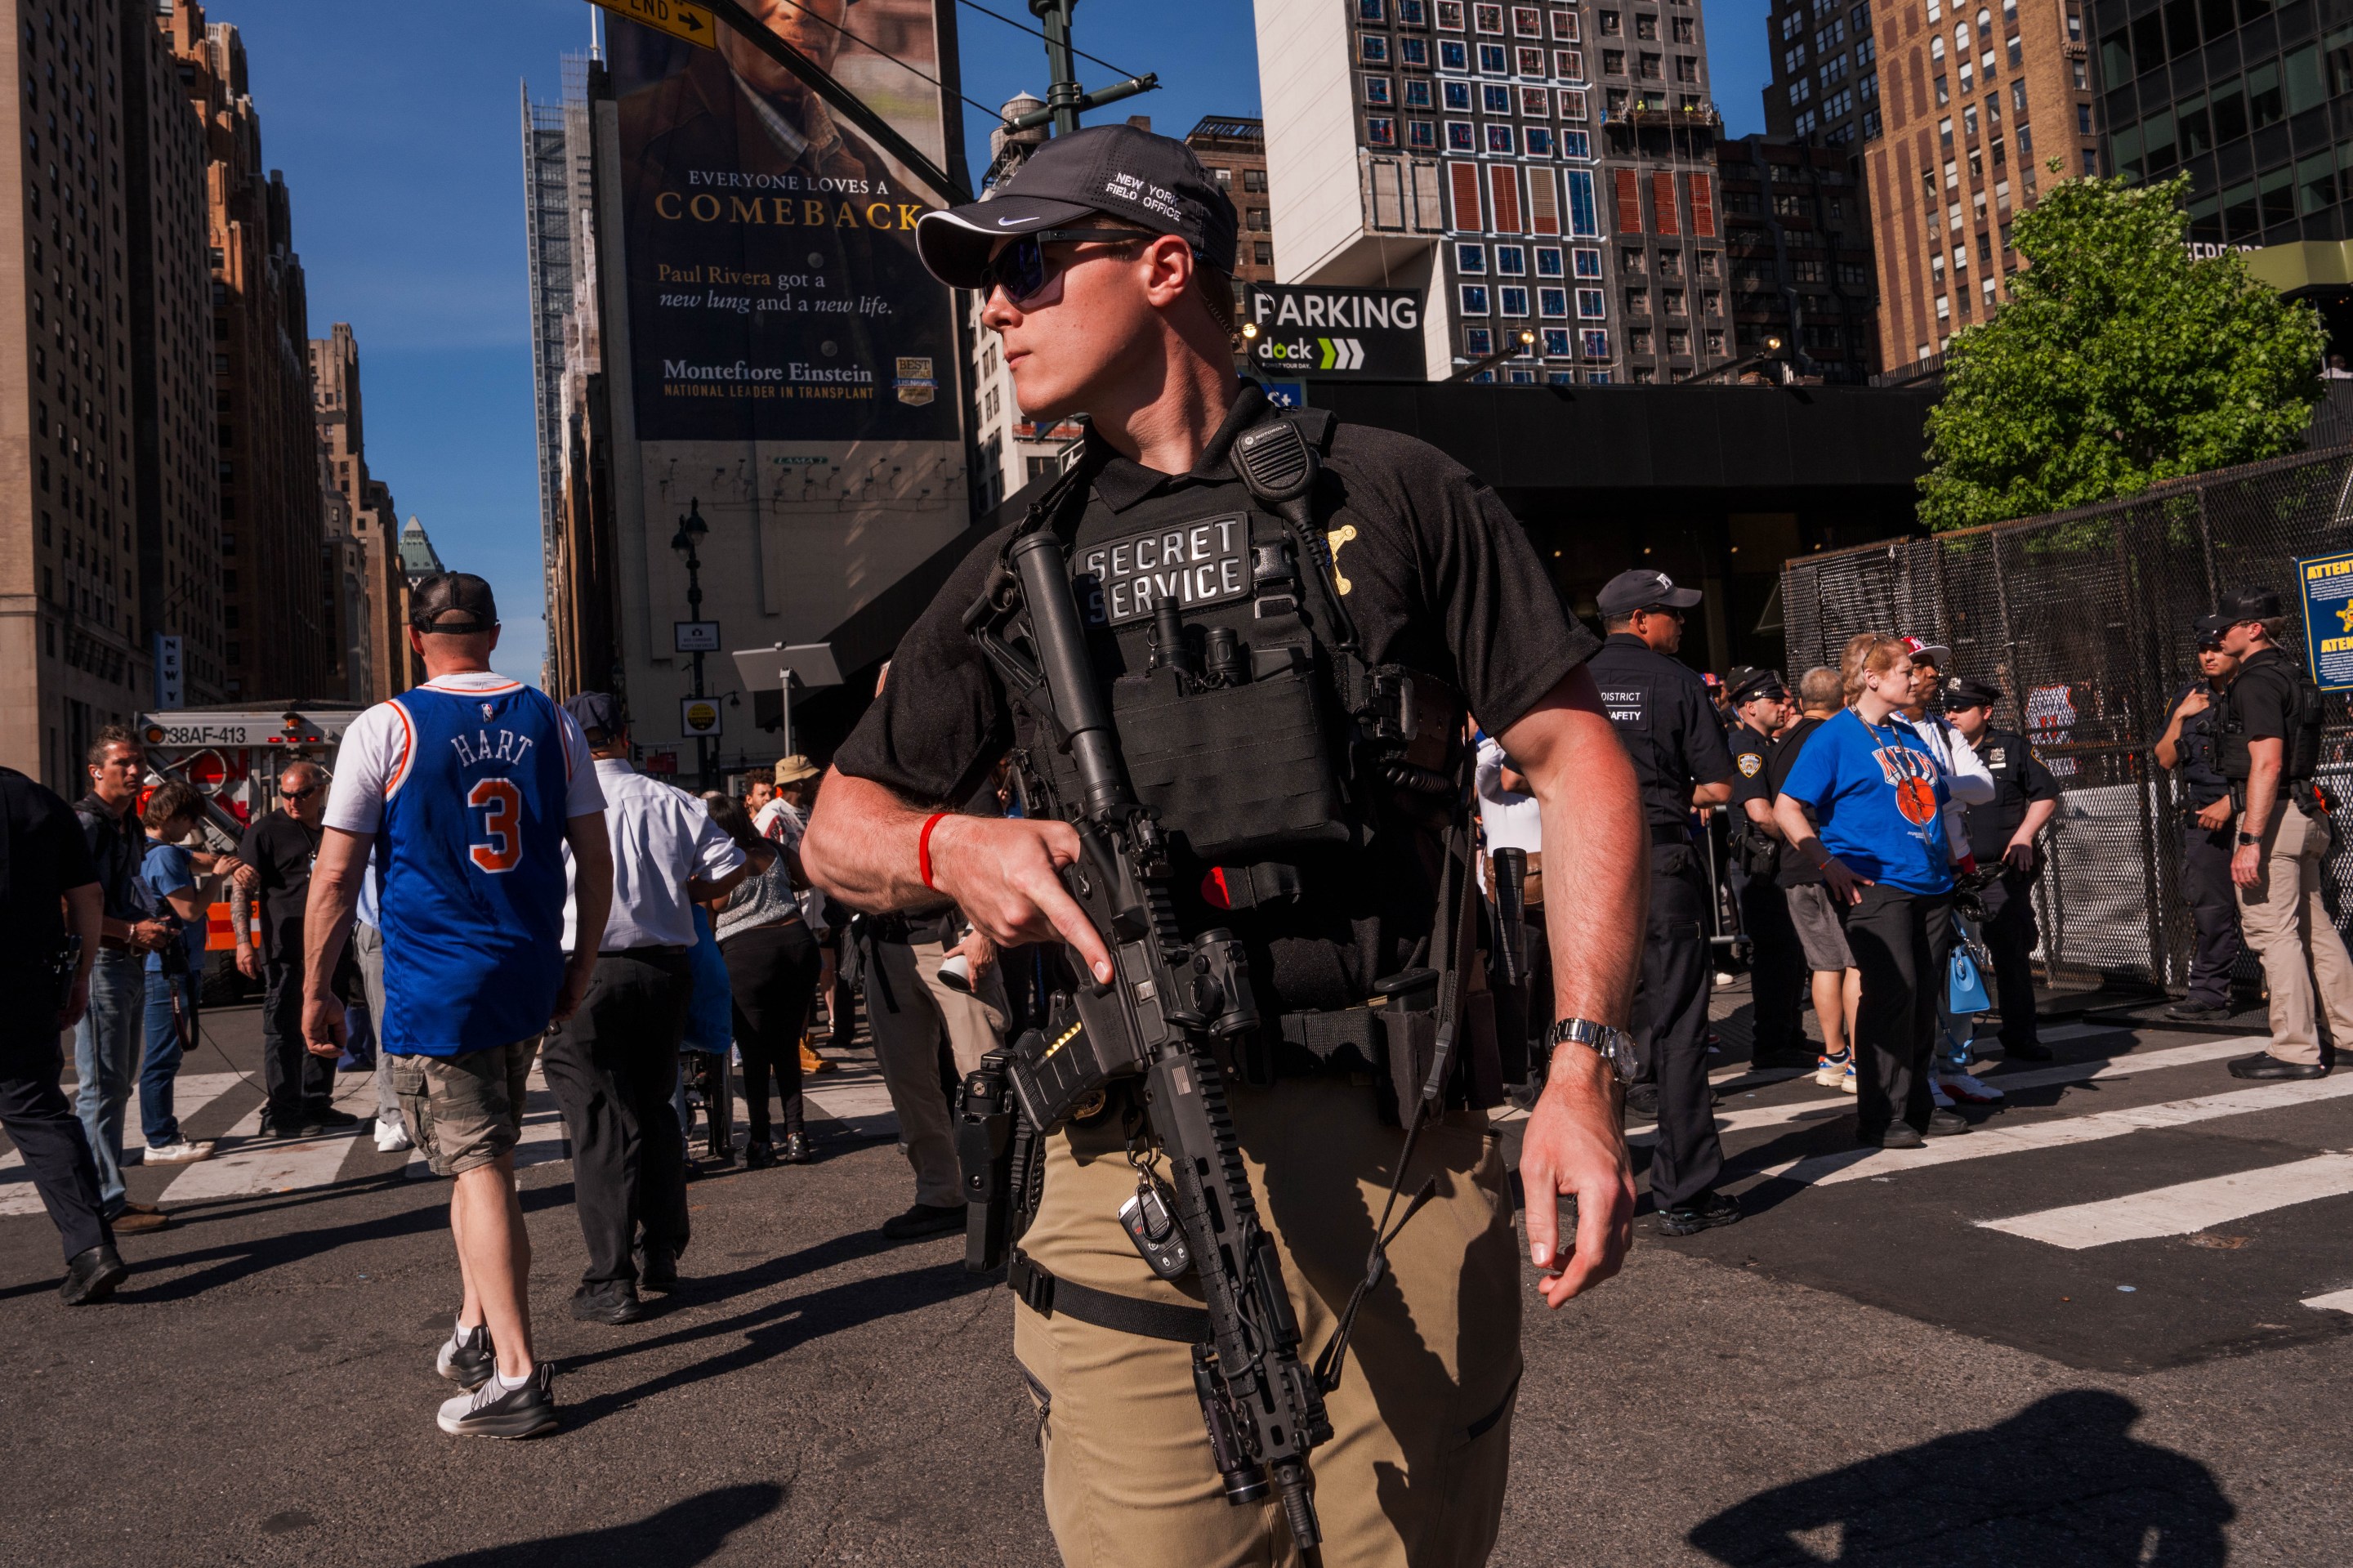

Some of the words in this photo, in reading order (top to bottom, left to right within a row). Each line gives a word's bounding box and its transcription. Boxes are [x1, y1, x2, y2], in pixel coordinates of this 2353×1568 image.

[689, 171, 799, 190] EVERYONE
[806, 176, 868, 194] LOVES
[877, 181, 889, 194] A
[1115, 172, 1144, 190] NEW
[1149, 184, 1179, 207] YORK
[655, 191, 922, 230] COMEBACK
[1105, 182, 1138, 201] FIELD
[1143, 196, 1181, 222] OFFICE
[658, 264, 700, 283] Paul
[708, 266, 771, 285] Rivera
[778, 275, 808, 290] got
[815, 277, 825, 288] a
[659, 292, 701, 307] new
[707, 290, 750, 314] lung
[757, 293, 792, 311] and
[797, 300, 808, 311] a
[815, 300, 853, 313] new
[859, 296, 893, 317] life.
[1254, 293, 1418, 329] PARKING
[1258, 337, 1313, 360] dock
[663, 360, 783, 381] Montefiore
[788, 362, 873, 382] Einstein
[899, 360, 930, 370] BEST
[664, 384, 723, 397] NATIONAL
[730, 385, 775, 397] LEADER
[780, 386, 793, 398] IN
[799, 386, 873, 399] TRANSPLANT
[1255, 424, 1287, 440] MOTOROLA
[1087, 518, 1238, 584] SECRET
[1088, 557, 1241, 623] SERVICE
[1601, 692, 1641, 701] DISTRICT
[169, 726, 246, 744] 38AF-413
[450, 729, 534, 767] HART
[467, 778, 523, 873] 3
